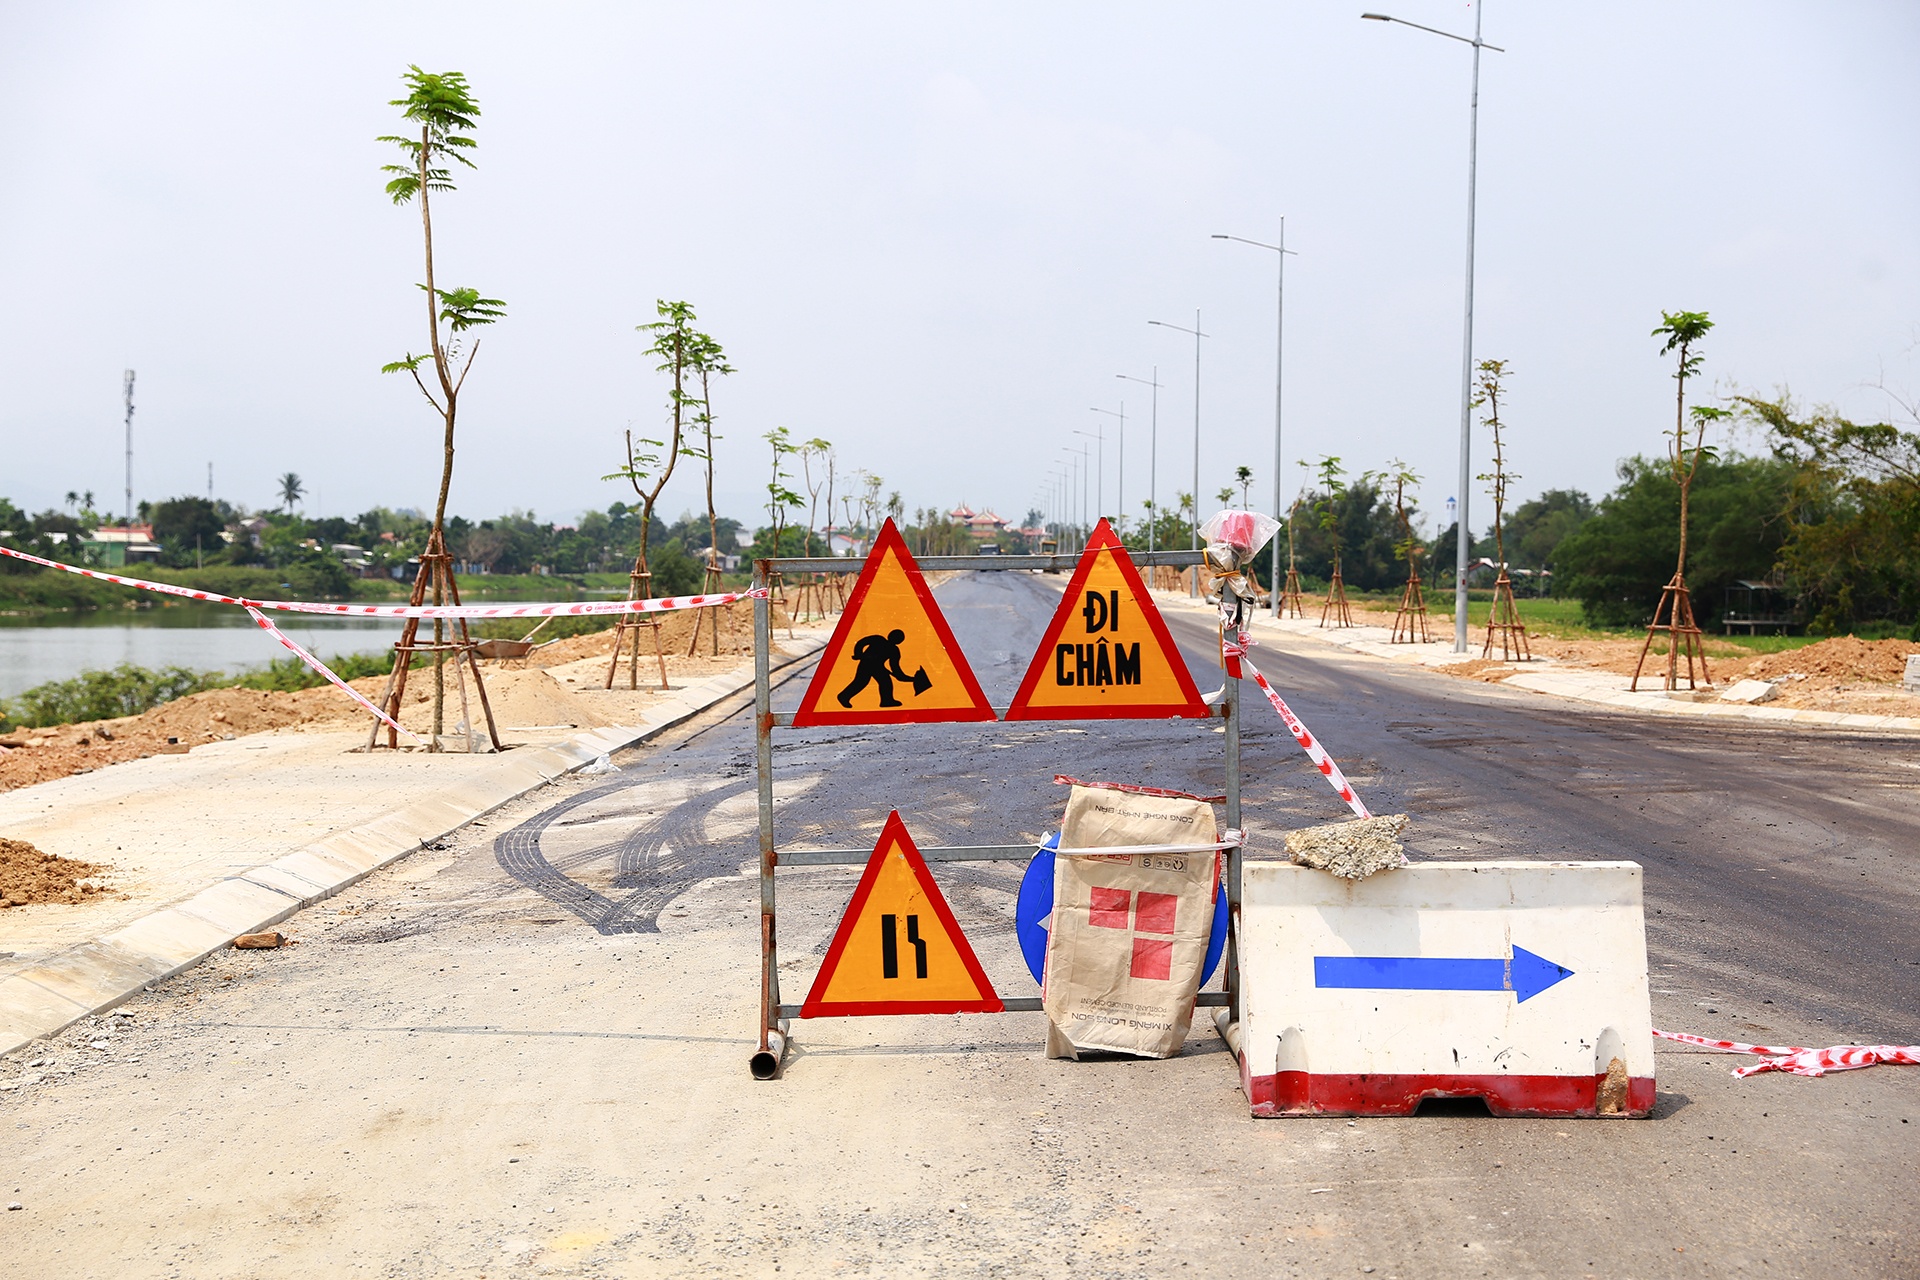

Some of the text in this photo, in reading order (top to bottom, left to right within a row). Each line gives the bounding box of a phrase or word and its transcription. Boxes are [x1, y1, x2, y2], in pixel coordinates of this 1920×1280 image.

[1083, 590, 1118, 633] ĐI
[1056, 636, 1141, 693] CHẬM
[1080, 998, 1106, 1006] CEMENT
[1107, 1001, 1134, 1010] BLENDED
[1134, 1003, 1167, 1013] PORTLAND
[1096, 1015, 1126, 1026] LONG
[1162, 1023, 1173, 1031] XI
